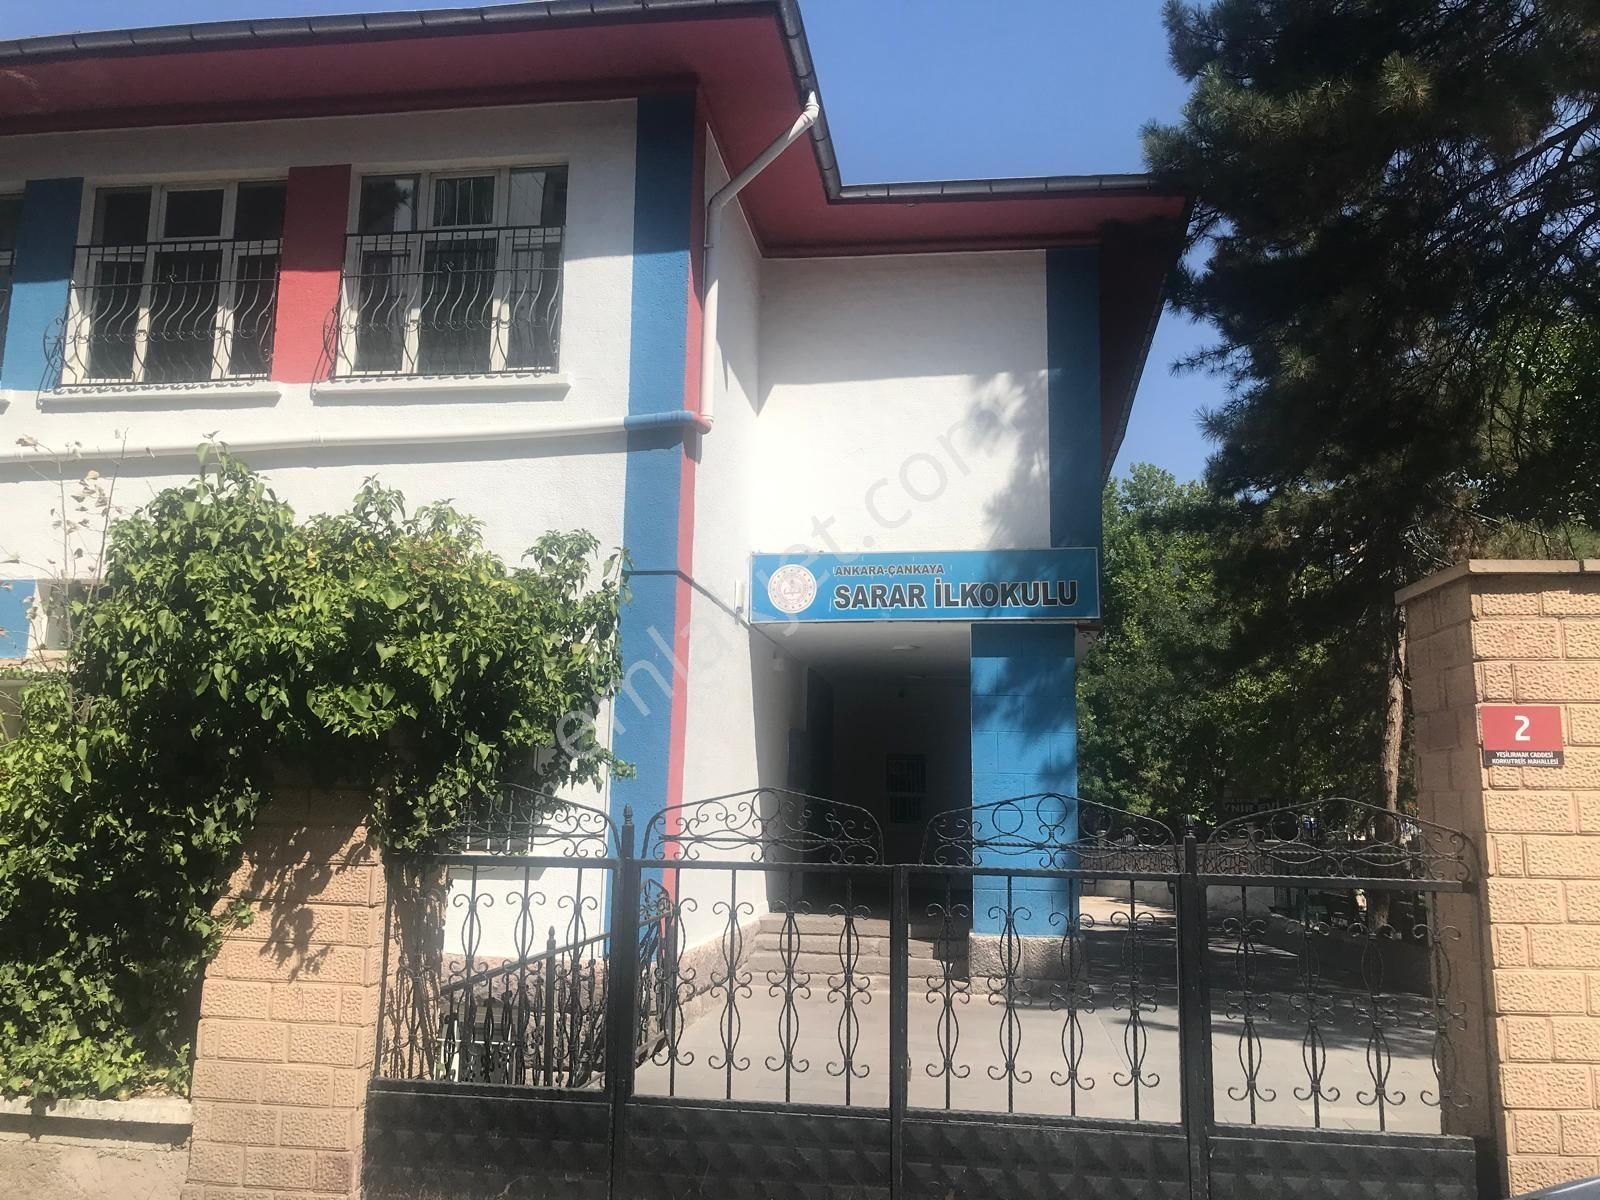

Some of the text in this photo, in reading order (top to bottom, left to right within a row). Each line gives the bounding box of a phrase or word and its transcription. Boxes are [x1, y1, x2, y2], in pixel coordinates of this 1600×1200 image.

[834, 564, 945, 577] ANKARA-ÇANKAYA
[834, 582, 926, 609] SARAR
[934, 578, 1078, 609] İLKOKULU
[1514, 715, 1531, 741] 2
